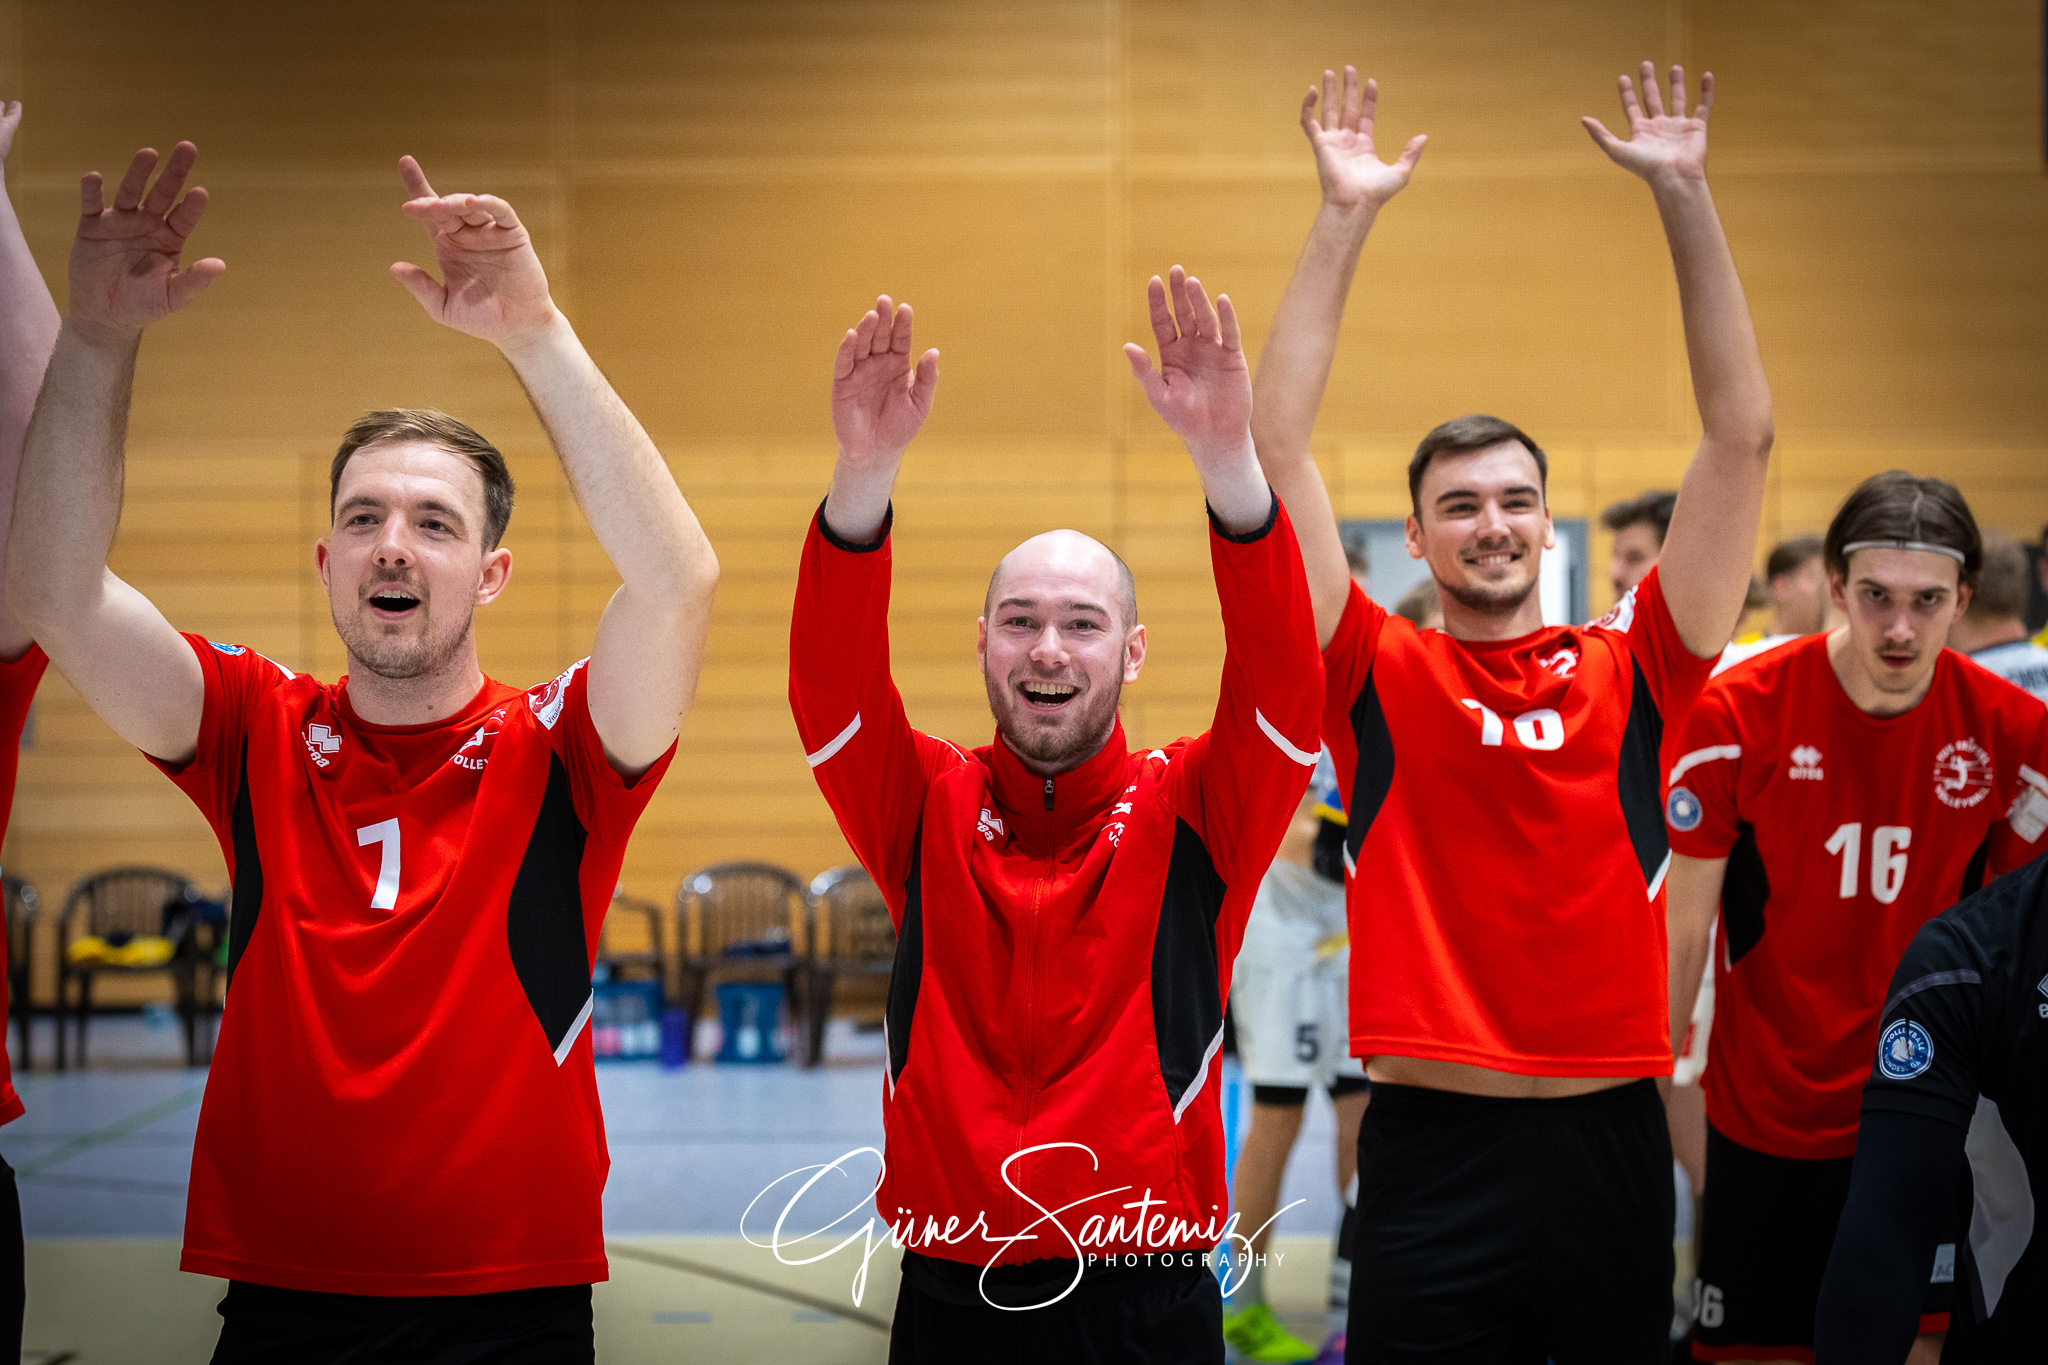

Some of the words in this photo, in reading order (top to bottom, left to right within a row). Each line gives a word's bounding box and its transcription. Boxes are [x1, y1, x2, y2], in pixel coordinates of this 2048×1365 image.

[357, 818, 400, 910] 7
[1825, 823, 1911, 903] 16
[1296, 1023, 1319, 1063] 5
[1884, 1054, 1921, 1072] BUNDESLGA
